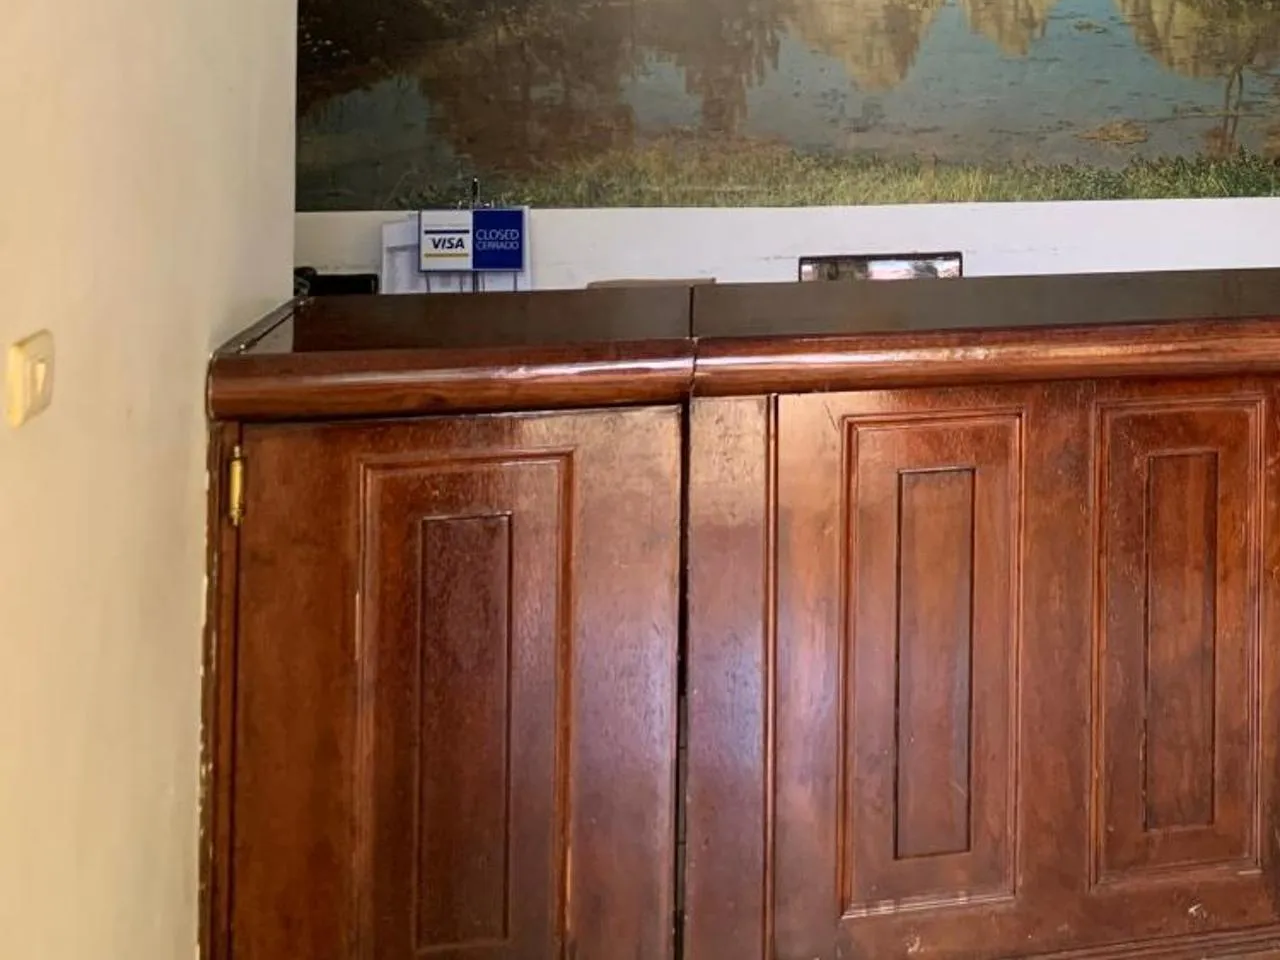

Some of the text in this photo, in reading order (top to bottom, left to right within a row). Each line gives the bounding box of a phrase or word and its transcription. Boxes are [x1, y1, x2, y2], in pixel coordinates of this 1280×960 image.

[475, 229, 520, 240] CLOSED
[431, 237, 465, 249] VISA
[475, 241, 520, 250] CERRADO
